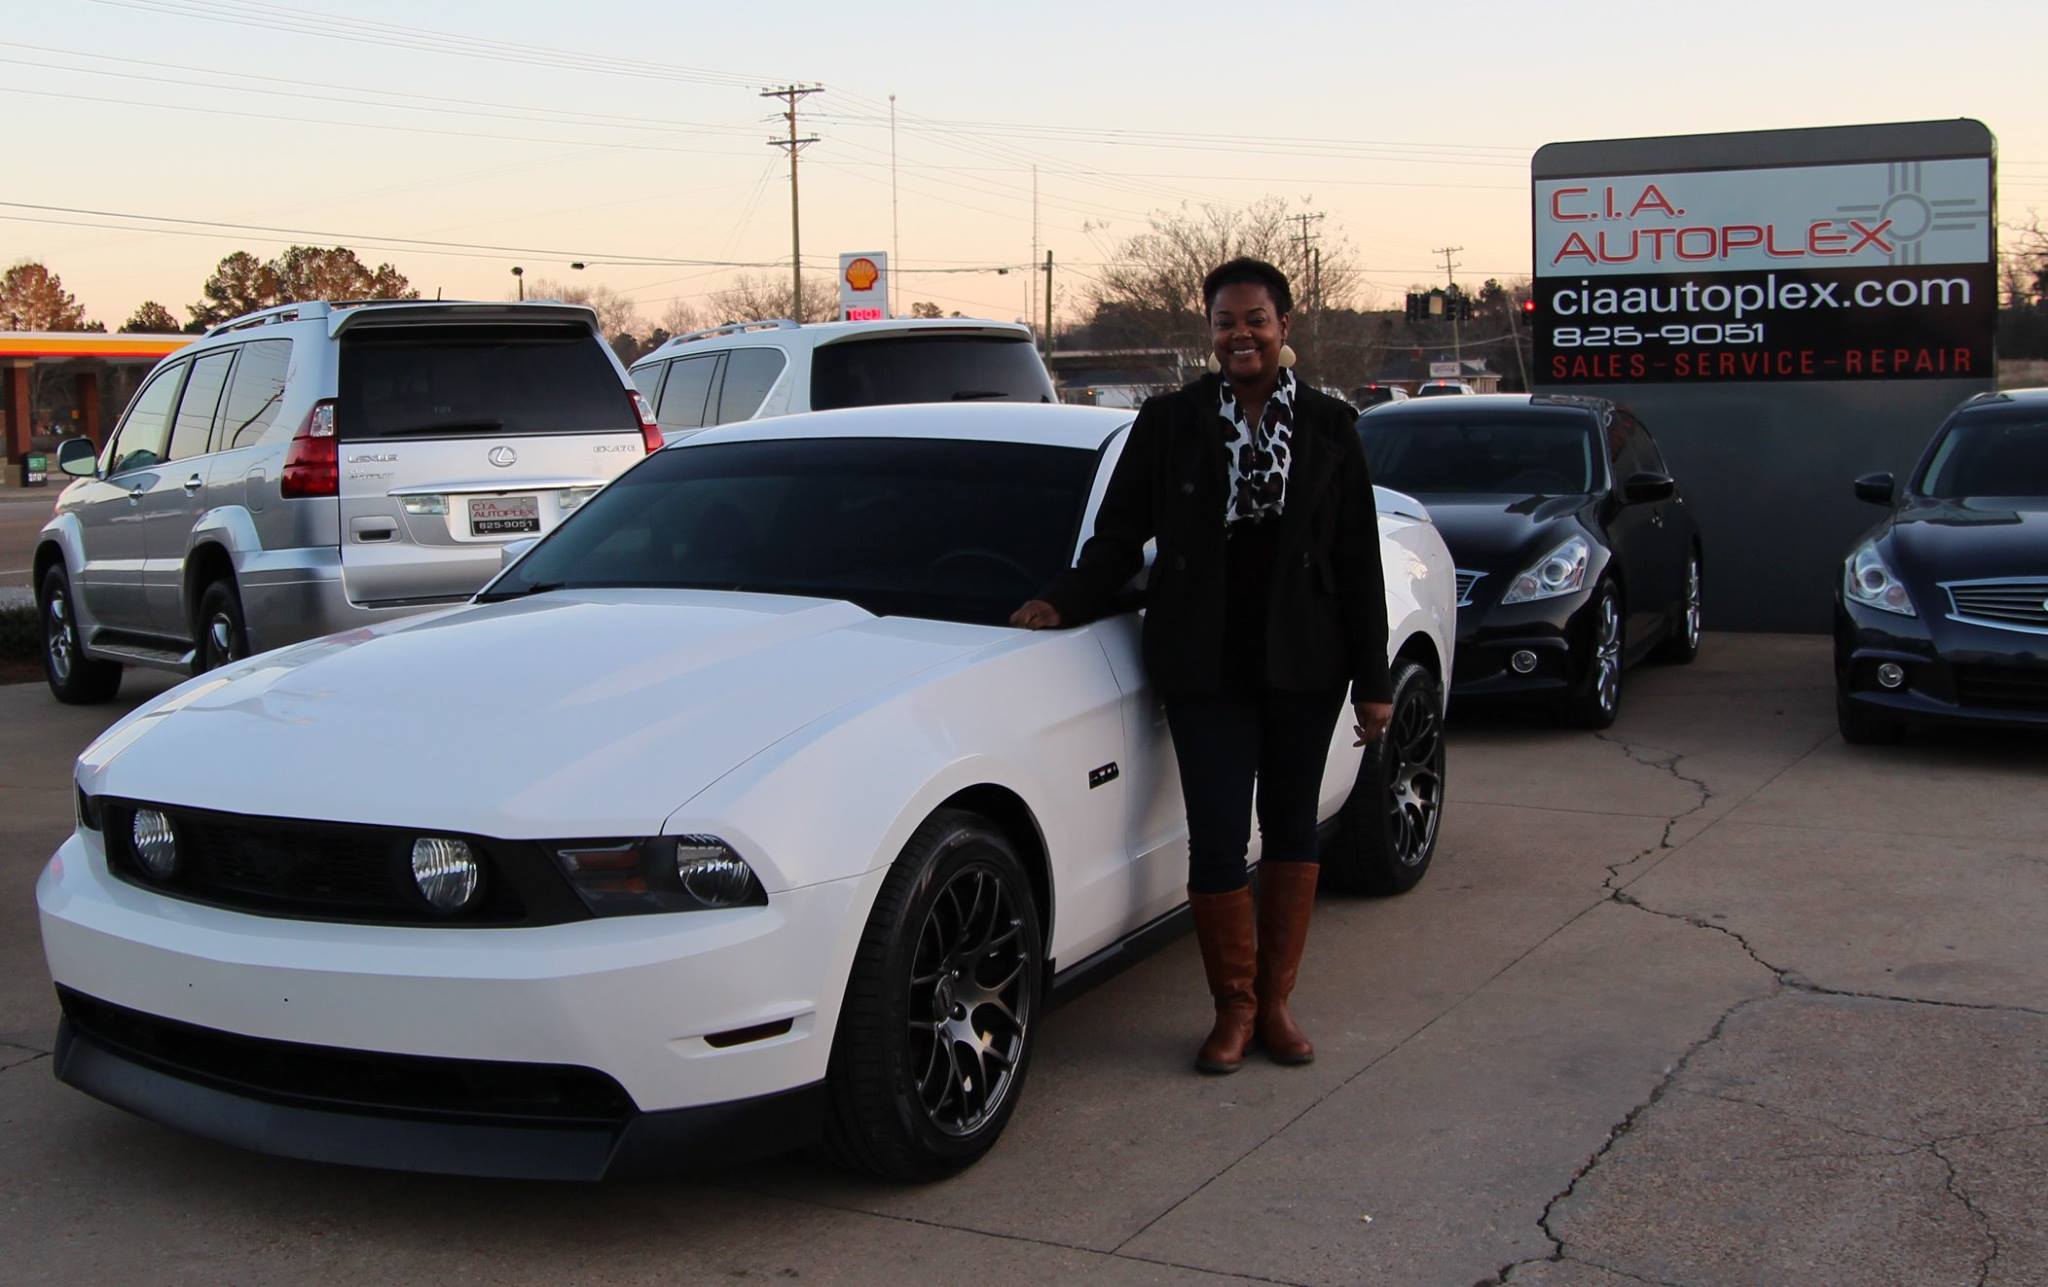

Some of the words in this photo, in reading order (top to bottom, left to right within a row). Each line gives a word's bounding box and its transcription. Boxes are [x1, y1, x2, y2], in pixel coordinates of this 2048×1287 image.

[1551, 184, 1687, 222] C.I.A.
[1551, 218, 1895, 267] AUTOPLEX
[1552, 274, 1971, 319] ciaautoplex.com
[1552, 323, 1764, 347] 825-9051
[473, 507, 537, 518] AUTOPLEX
[479, 520, 533, 530] 825-9051
